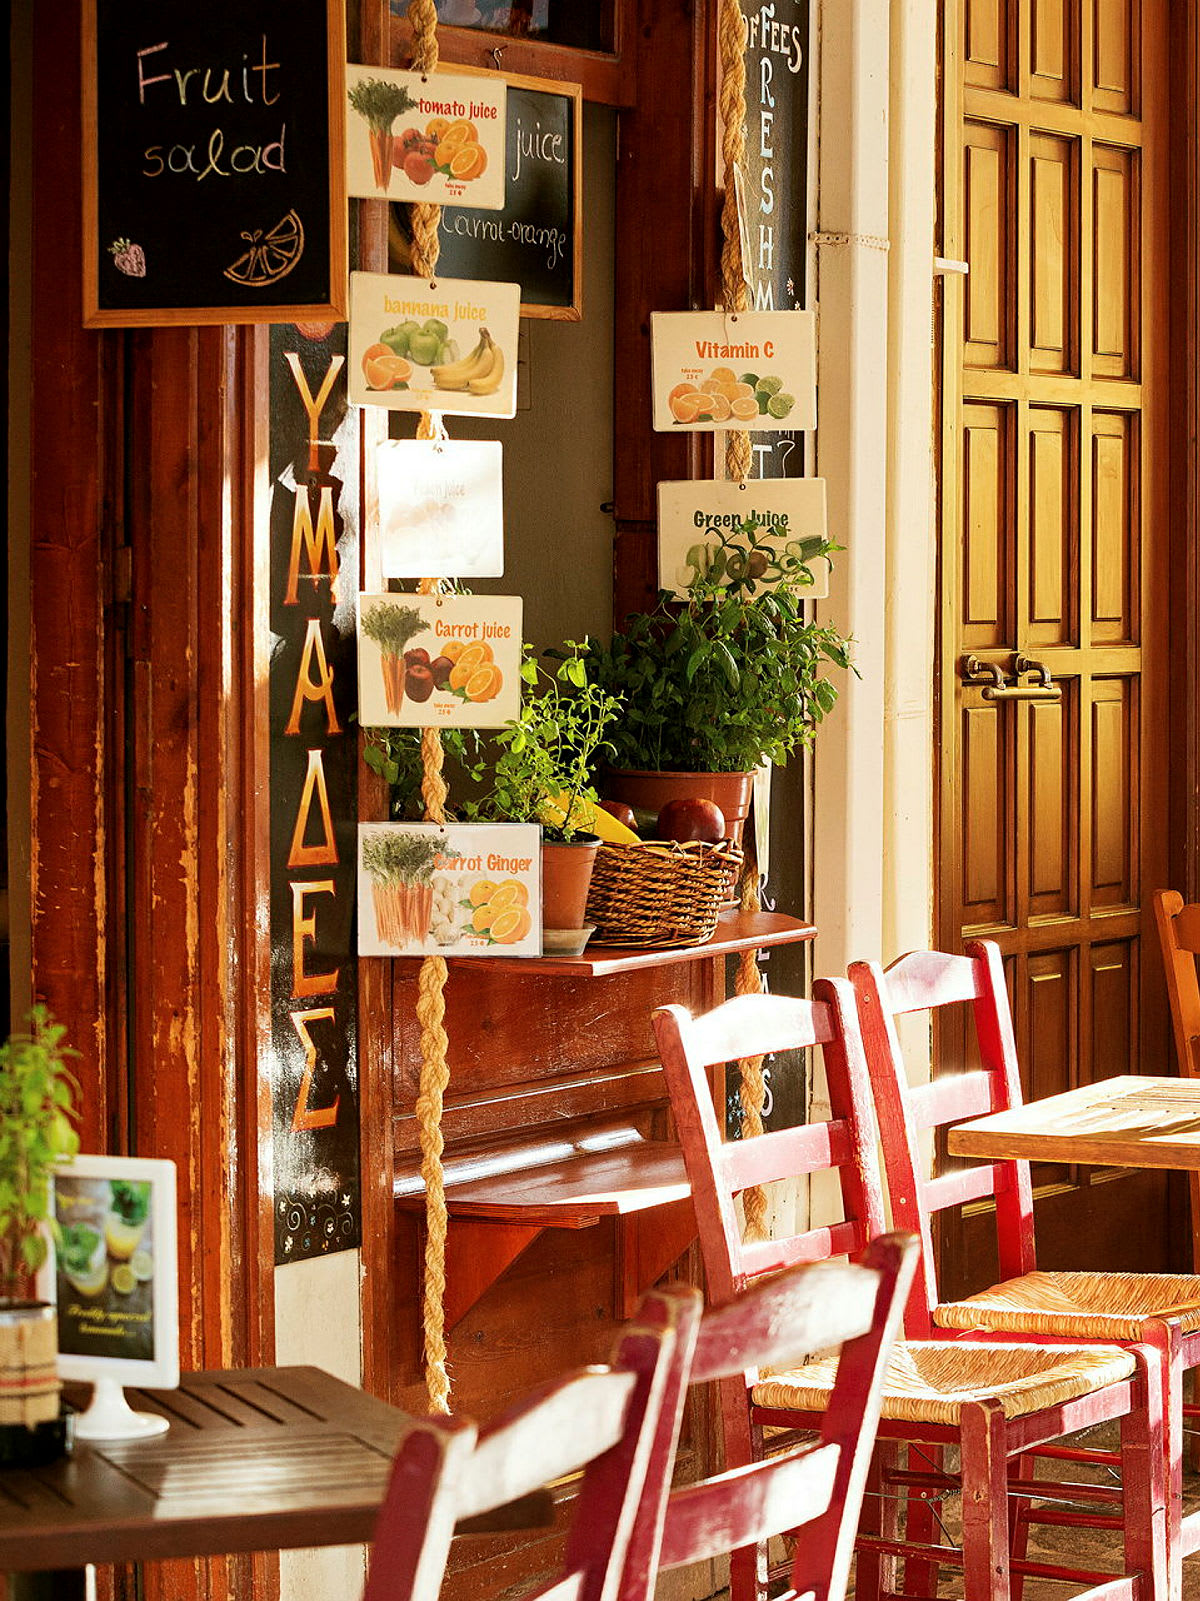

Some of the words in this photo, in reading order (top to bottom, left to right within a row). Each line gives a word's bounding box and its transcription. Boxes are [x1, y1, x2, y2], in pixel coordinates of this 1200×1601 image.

[137, 34, 282, 106] Fruit
[419, 98, 466, 118] tomato
[468, 102, 498, 121] juice
[142, 122, 288, 181] salad
[512, 119, 565, 182] juice
[384, 295, 449, 318] bannana
[454, 297, 487, 321] juice
[695, 341, 759, 359] Vitamin
[763, 341, 775, 359] C
[693, 510, 742, 528] Green
[435, 619, 479, 639] Carrot
[481, 620, 511, 641] juice
[433, 853, 482, 871] Carrot
[487, 853, 532, 875] Ginger
